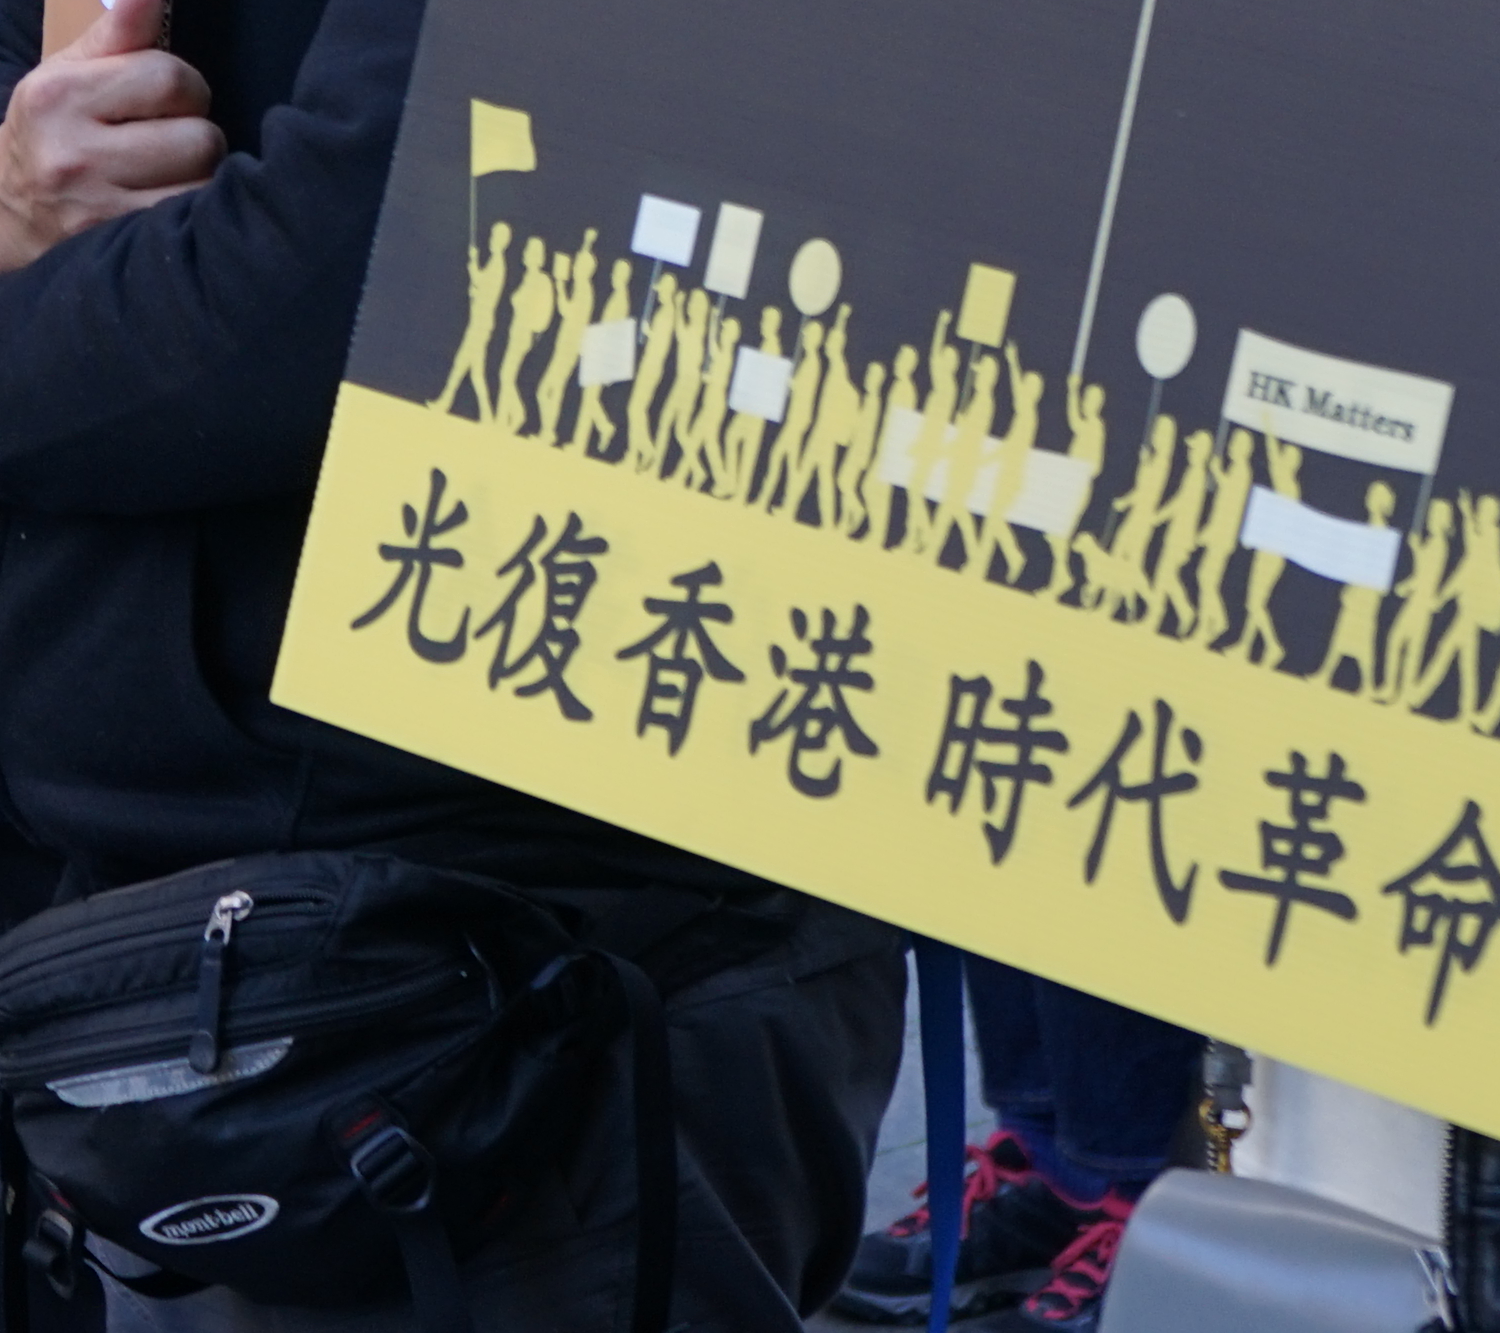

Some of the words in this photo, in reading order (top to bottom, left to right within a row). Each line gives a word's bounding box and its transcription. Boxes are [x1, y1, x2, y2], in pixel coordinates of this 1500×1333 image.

[1247, 371, 1297, 410] HK
[1302, 386, 1416, 444] Matters
[351, 466, 881, 800] 光復香港
